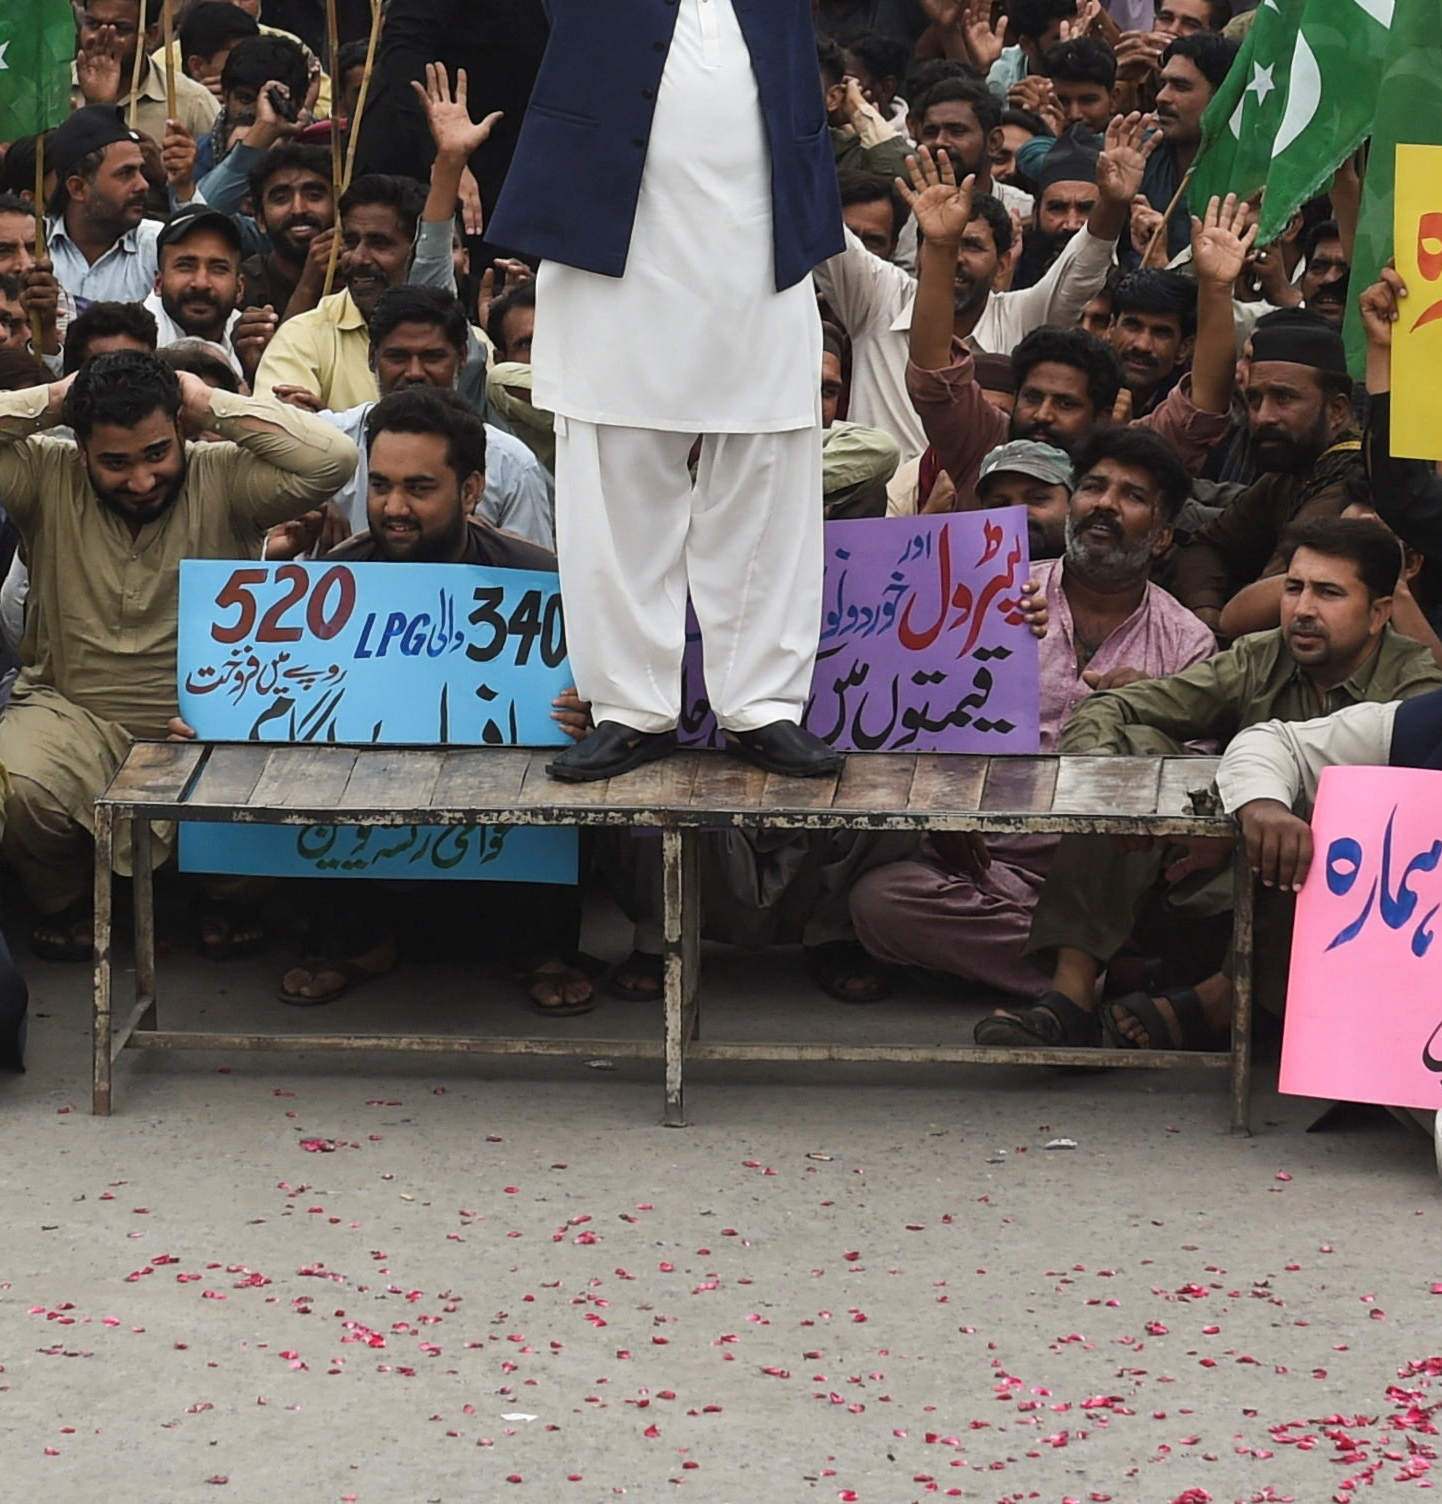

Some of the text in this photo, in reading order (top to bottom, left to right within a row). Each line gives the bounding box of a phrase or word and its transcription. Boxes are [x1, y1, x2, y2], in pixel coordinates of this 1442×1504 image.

[898, 531, 932, 565] اور
[210, 564, 356, 645] 520
[353, 611, 431, 660] LPG
[465, 586, 569, 669] 340
[184, 643, 261, 708] فروخت
[256, 651, 292, 697] میں
[852, 645, 1017, 750] قیمتوں
